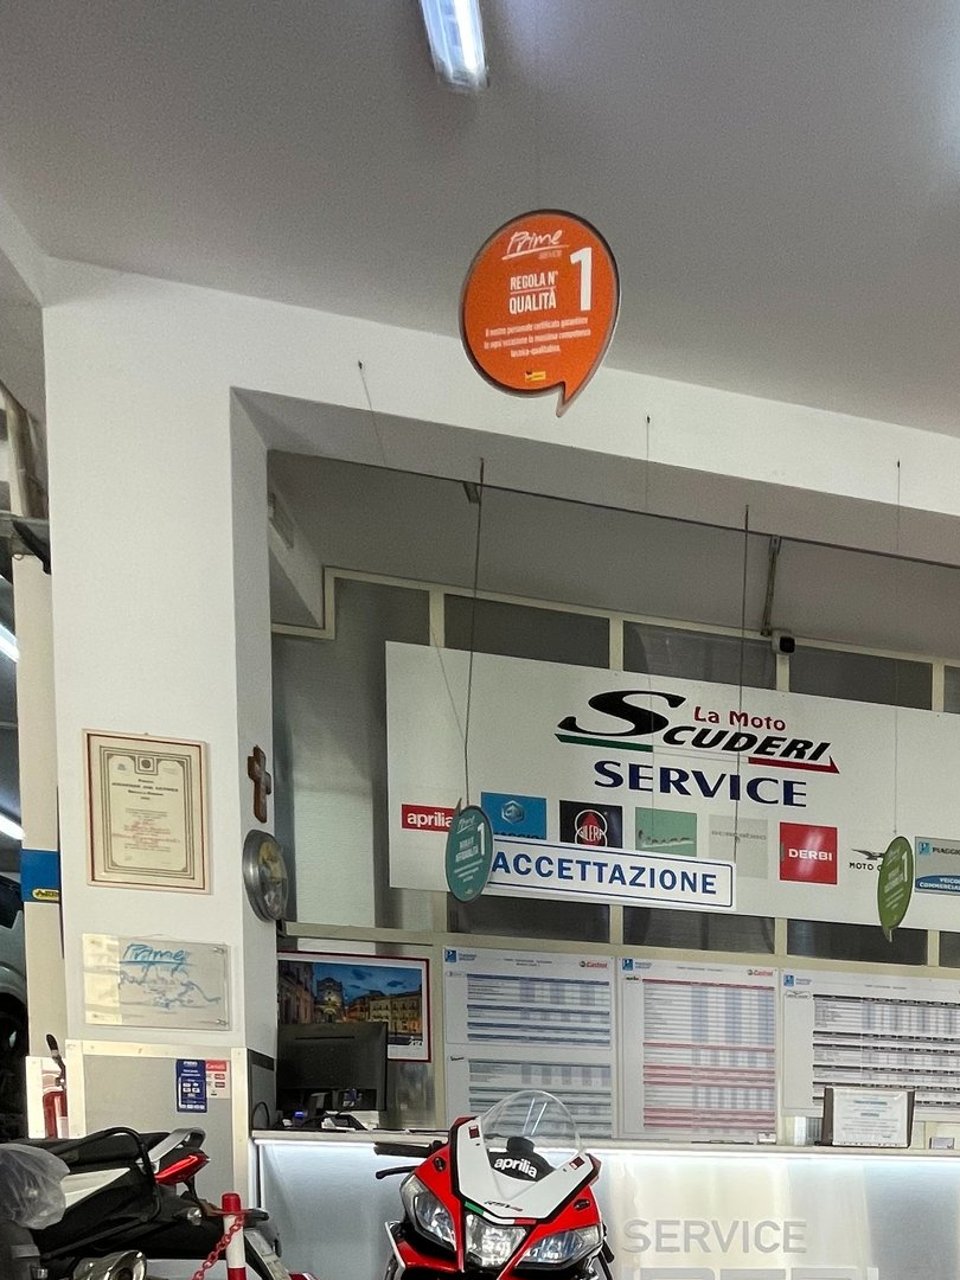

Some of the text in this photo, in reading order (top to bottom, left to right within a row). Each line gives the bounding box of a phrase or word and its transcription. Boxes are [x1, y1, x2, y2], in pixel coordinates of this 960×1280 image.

[510, 272, 545, 291] REGOLA
[569, 247, 592, 311] 1
[509, 287, 557, 315] QUALITÀ
[557, 690, 832, 761] SCUDERI
[694, 706, 786, 732] La Moto
[594, 760, 807, 808] SERVICE
[407, 812, 453, 828] aprilia
[477, 822, 486, 856] 1
[788, 848, 833, 862] DERBI
[849, 862, 874, 871] MOTO
[491, 851, 717, 895] ACCETTAZIONE
[494, 1158, 539, 1180] aprilia
[622, 1219, 808, 1254] SERVICE
